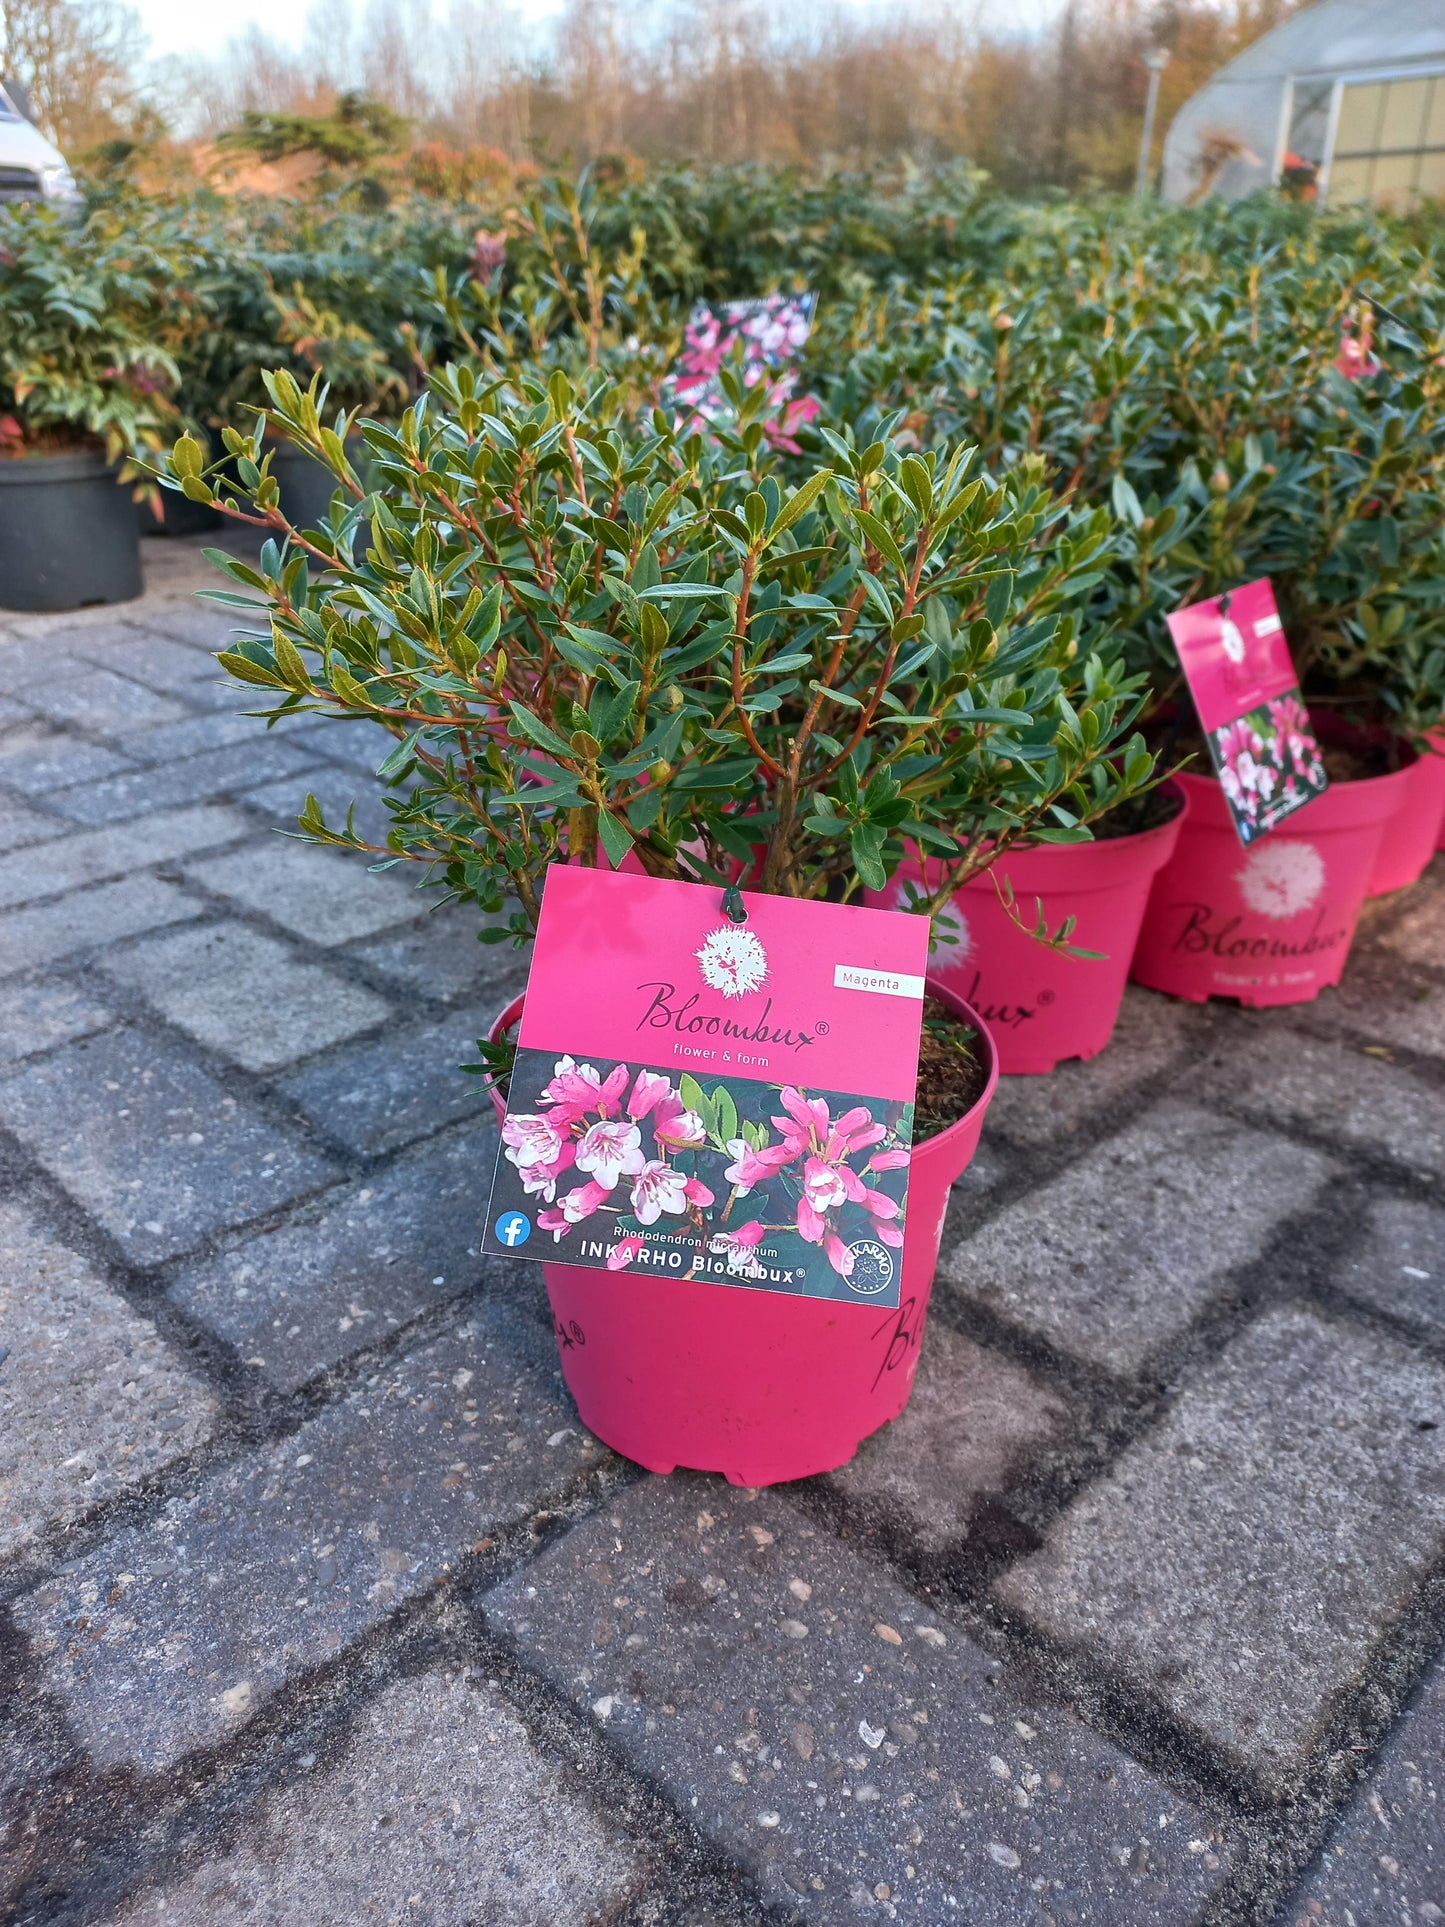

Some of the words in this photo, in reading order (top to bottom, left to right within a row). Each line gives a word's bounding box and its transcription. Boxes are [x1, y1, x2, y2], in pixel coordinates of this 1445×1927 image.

[843, 973, 899, 989] Magenta
[673, 1043, 716, 1059] flower
[722, 1050, 731, 1062] &
[737, 1051, 769, 1067] form
[580, 1240, 682, 1268] INKARHO
[613, 1226, 702, 1247] Rhododendron
[706, 1240, 778, 1258] micranthum
[844, 1243, 890, 1275] INKARHO
